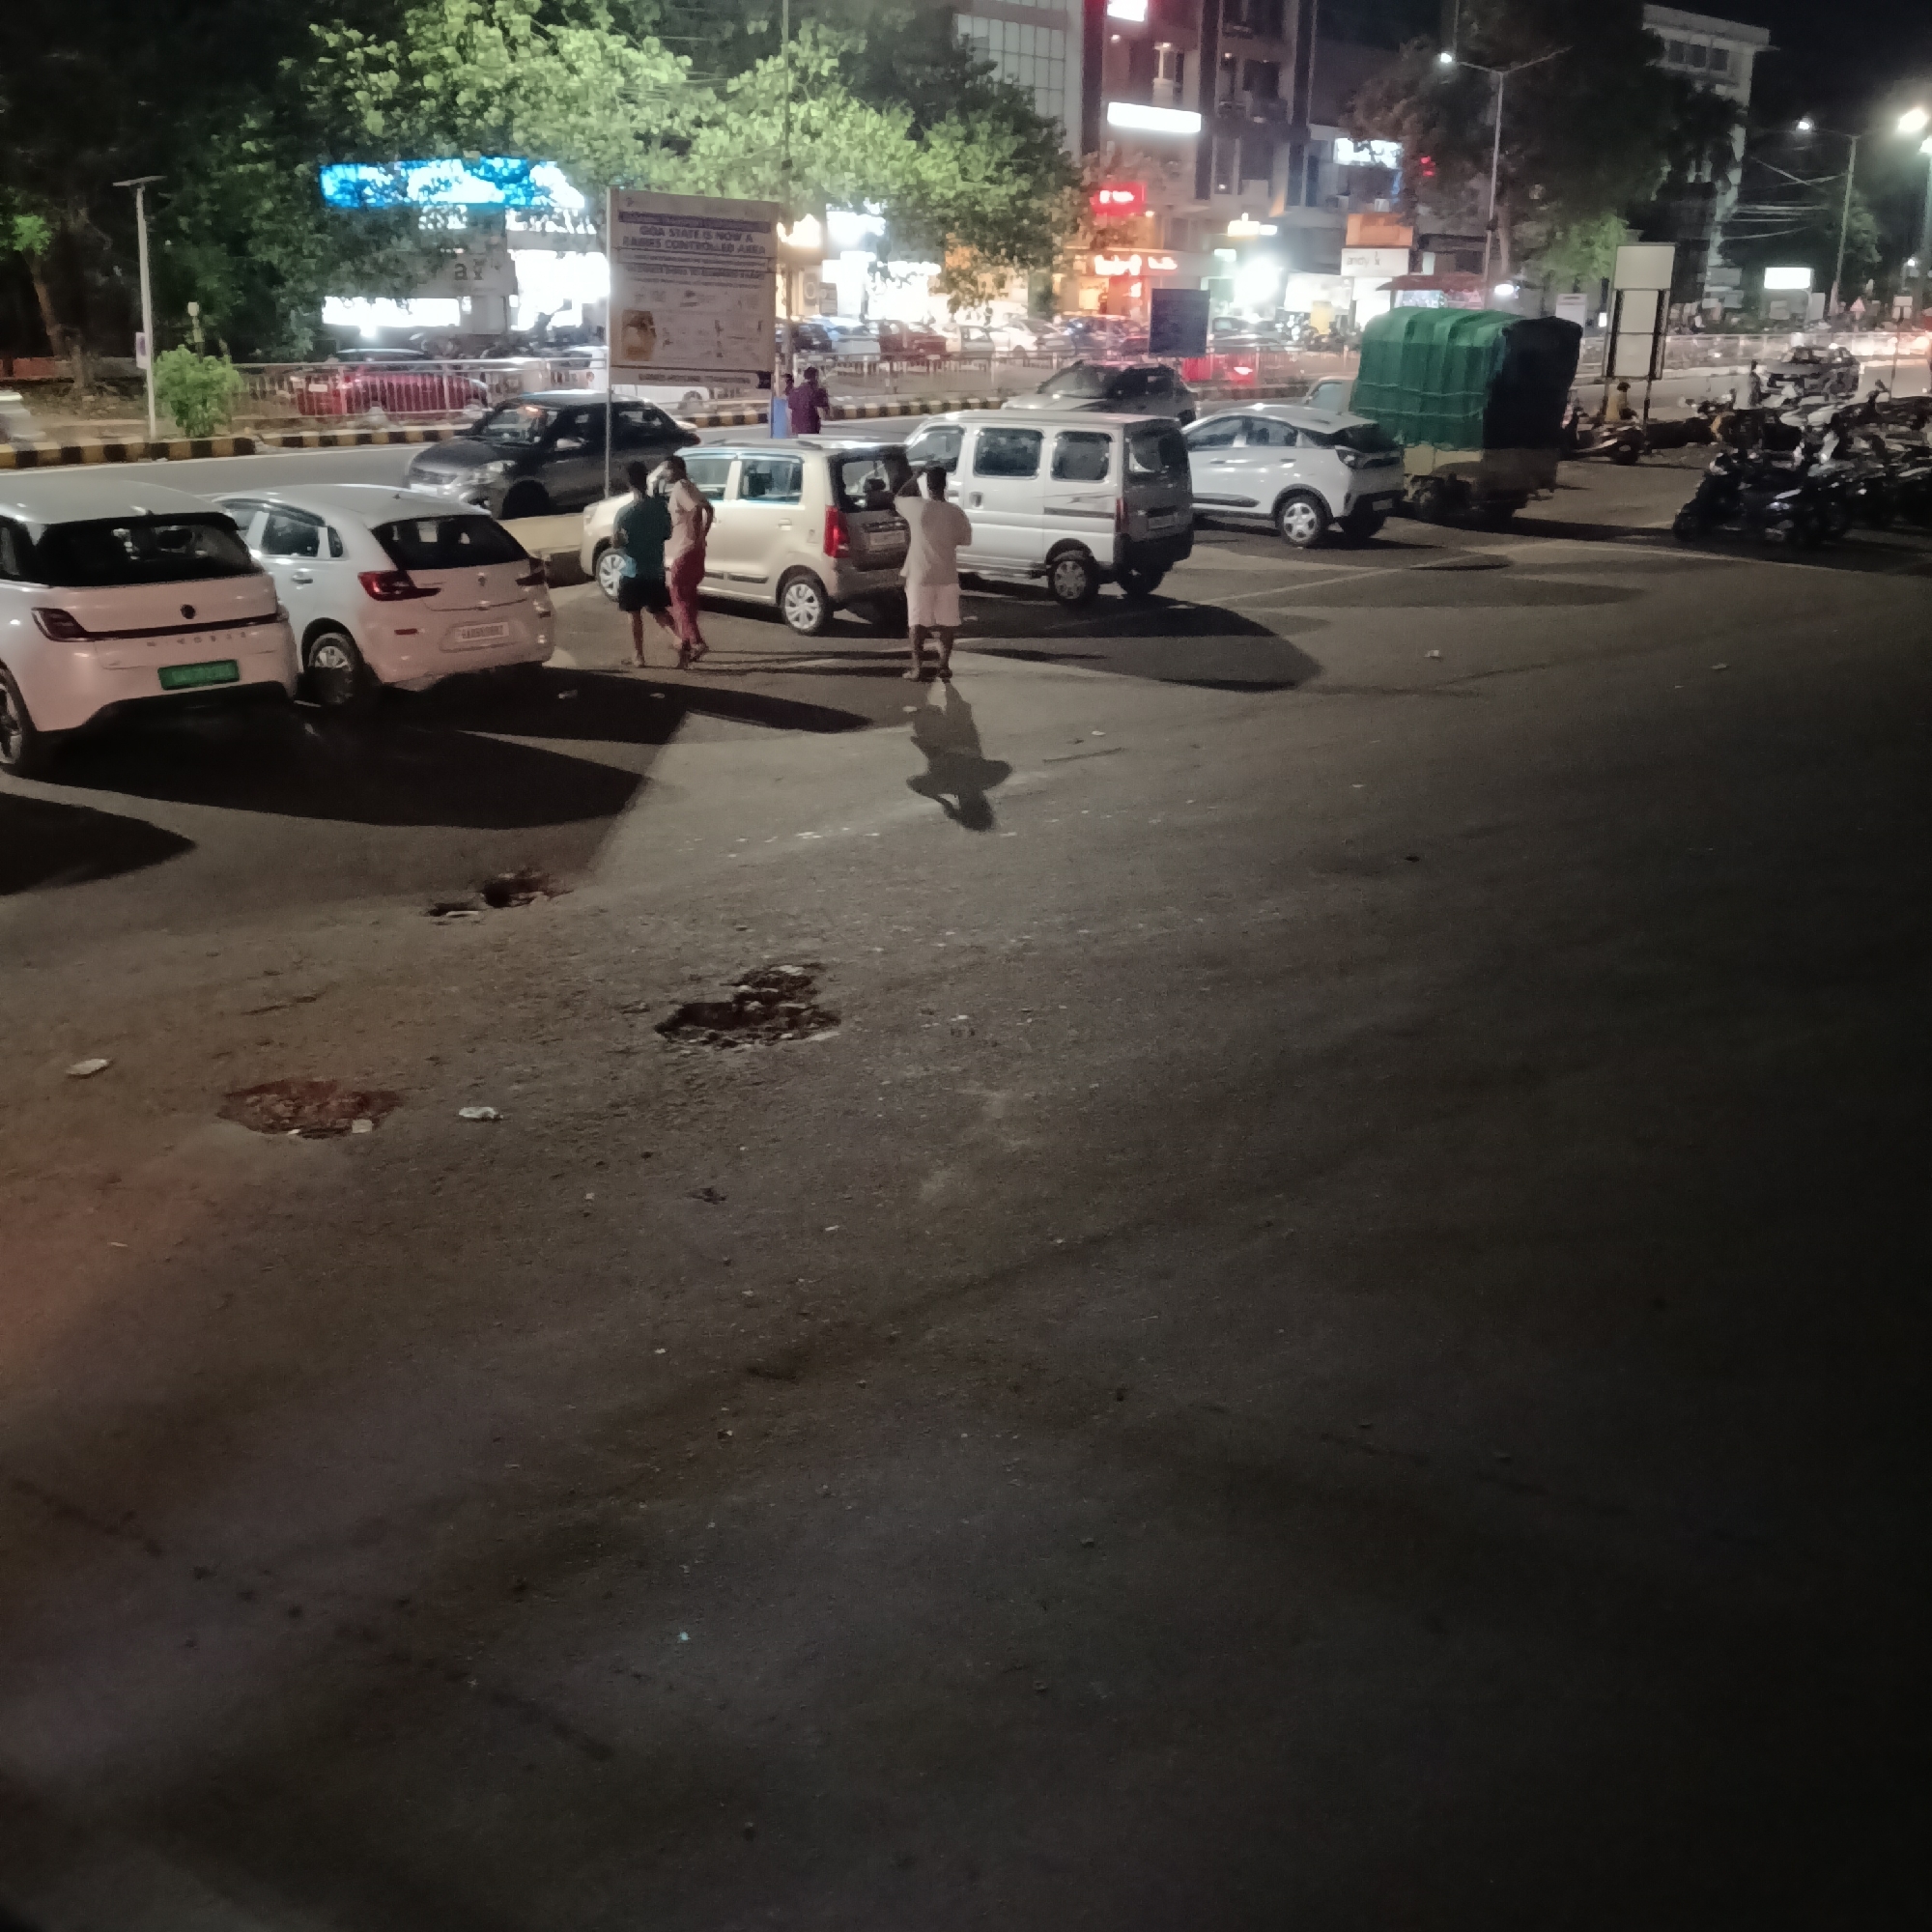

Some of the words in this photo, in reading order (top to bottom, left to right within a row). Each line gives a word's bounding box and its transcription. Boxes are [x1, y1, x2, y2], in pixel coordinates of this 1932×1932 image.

[669, 228, 699, 239] STATE
[717, 232, 742, 242] NOW
[738, 244, 765, 254] AREA
